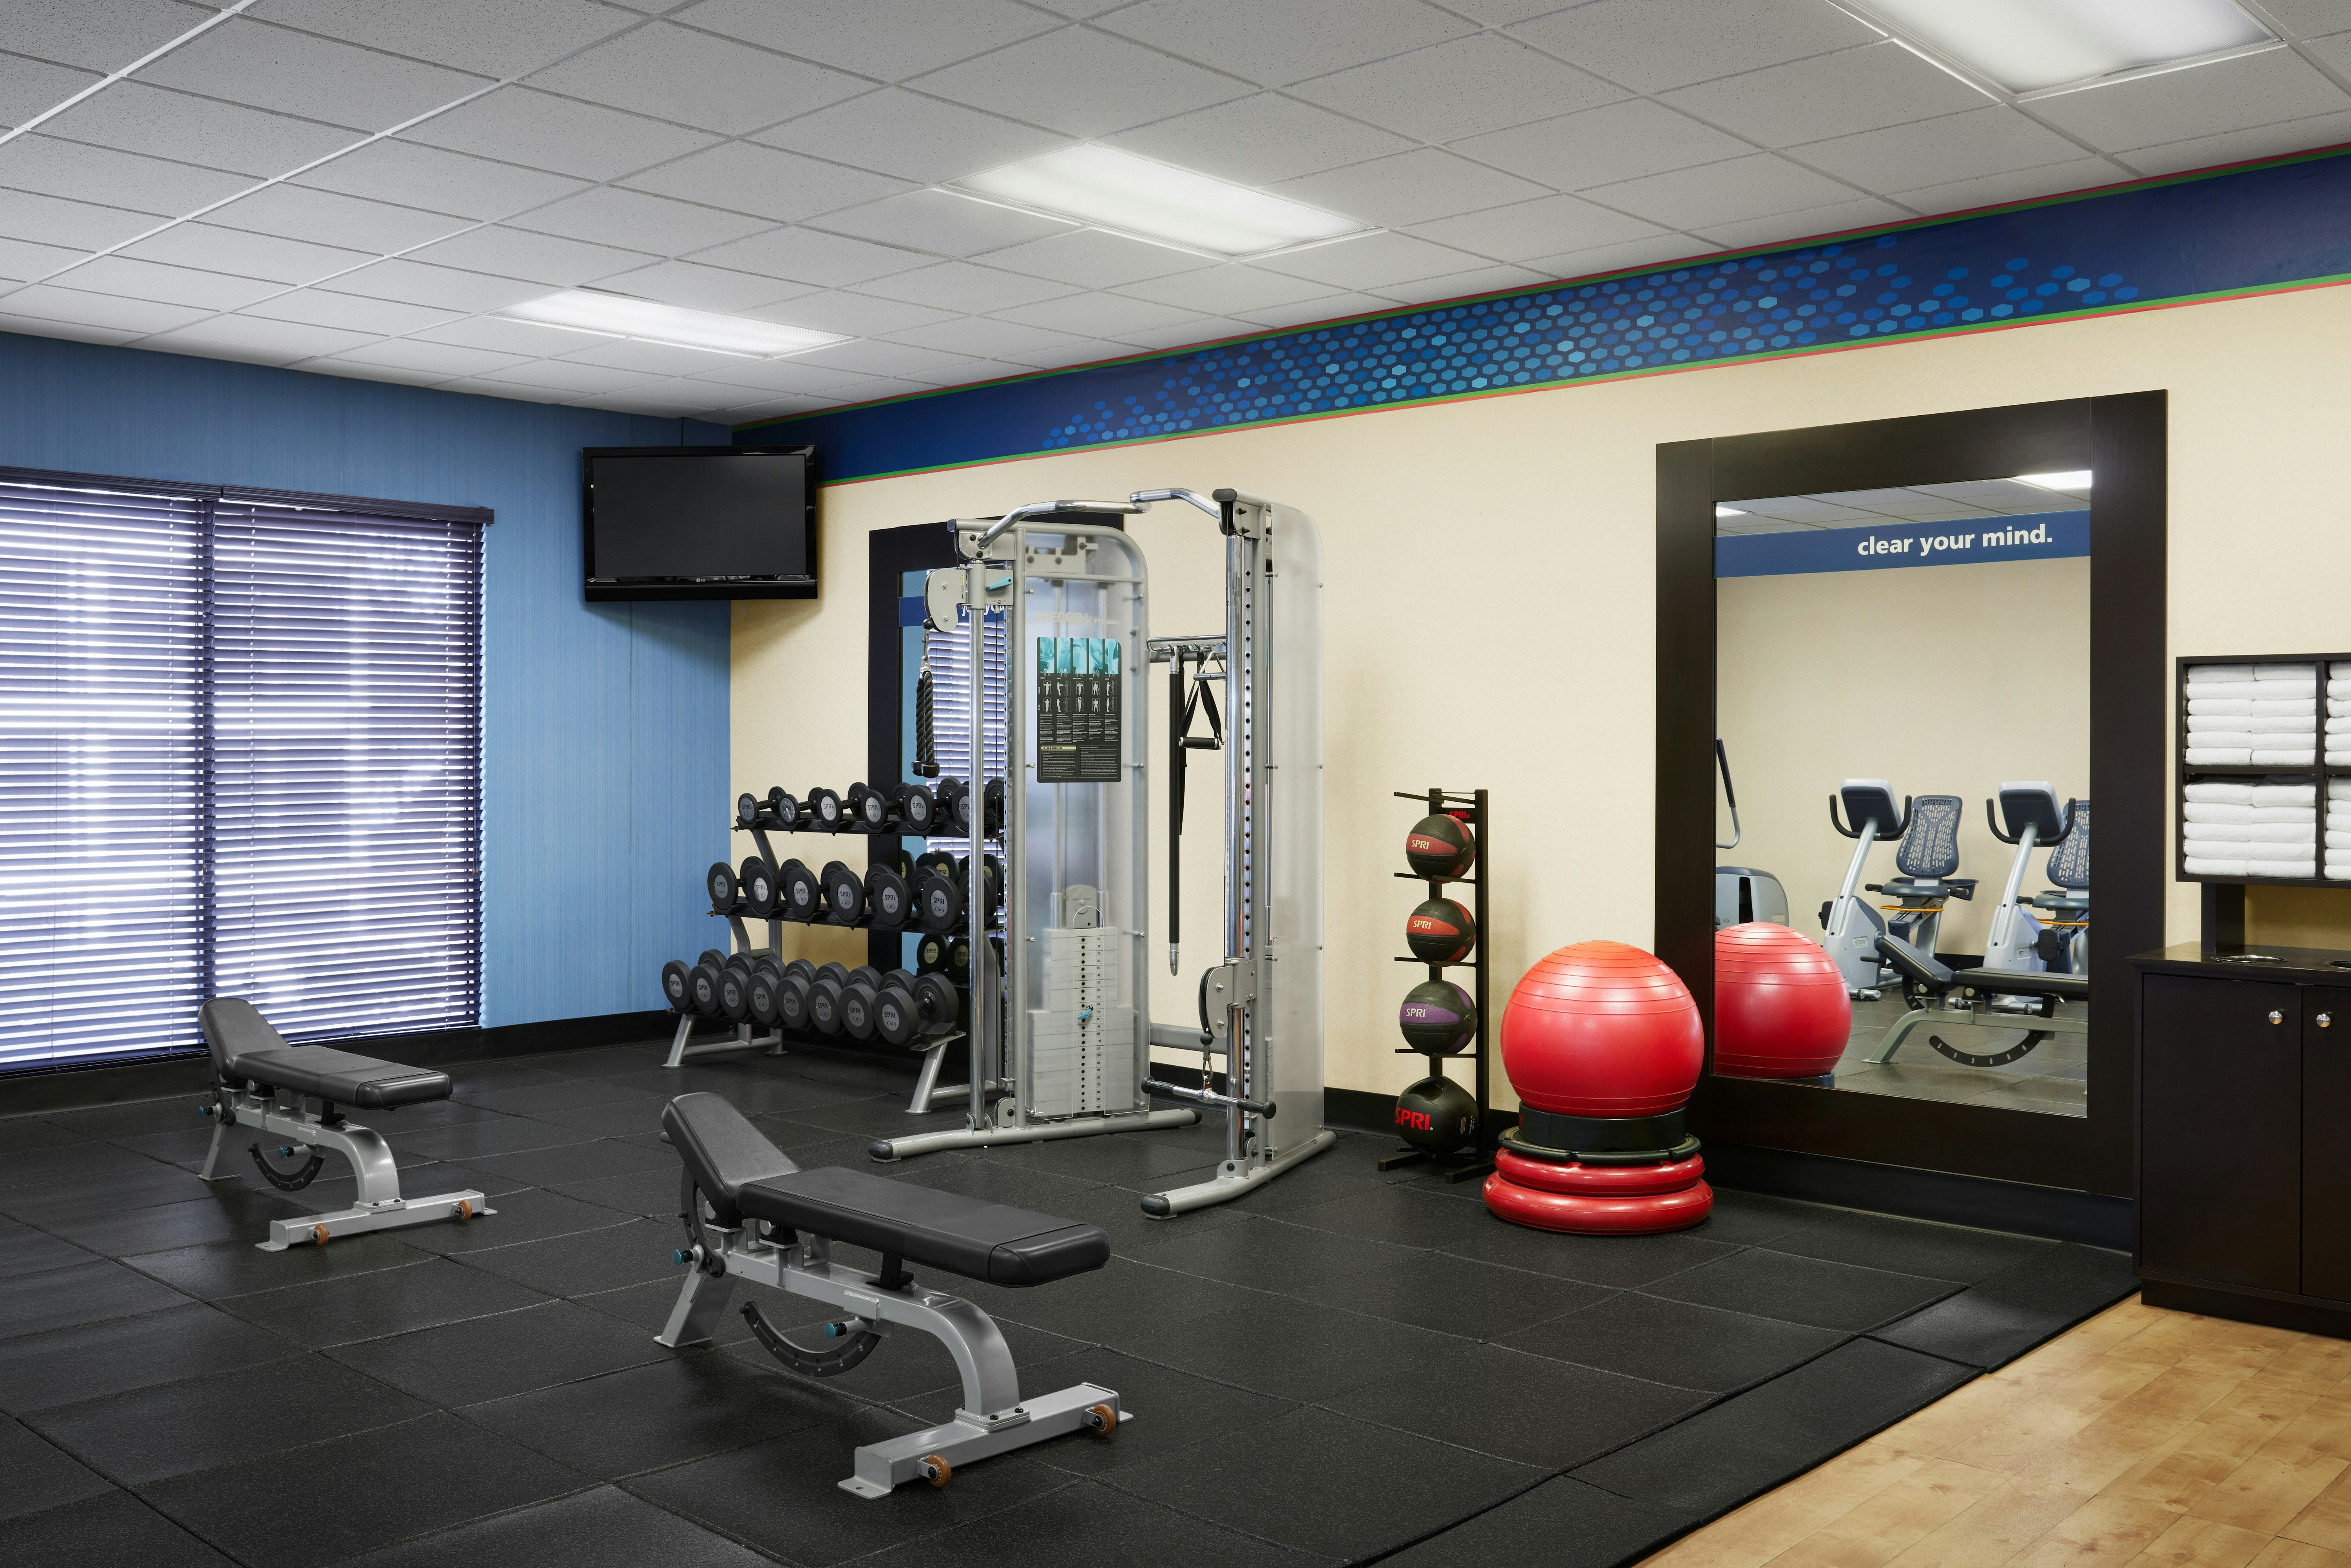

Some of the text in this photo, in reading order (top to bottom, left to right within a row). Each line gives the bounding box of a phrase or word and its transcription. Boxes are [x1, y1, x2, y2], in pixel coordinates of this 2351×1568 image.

[1858, 524, 2052, 556] clear your mind.
[1411, 839, 1429, 849] SPRI
[1413, 920, 1432, 929] SPRI
[1406, 1008, 1426, 1018] SPRI
[1395, 1107, 1430, 1131] SPRI
